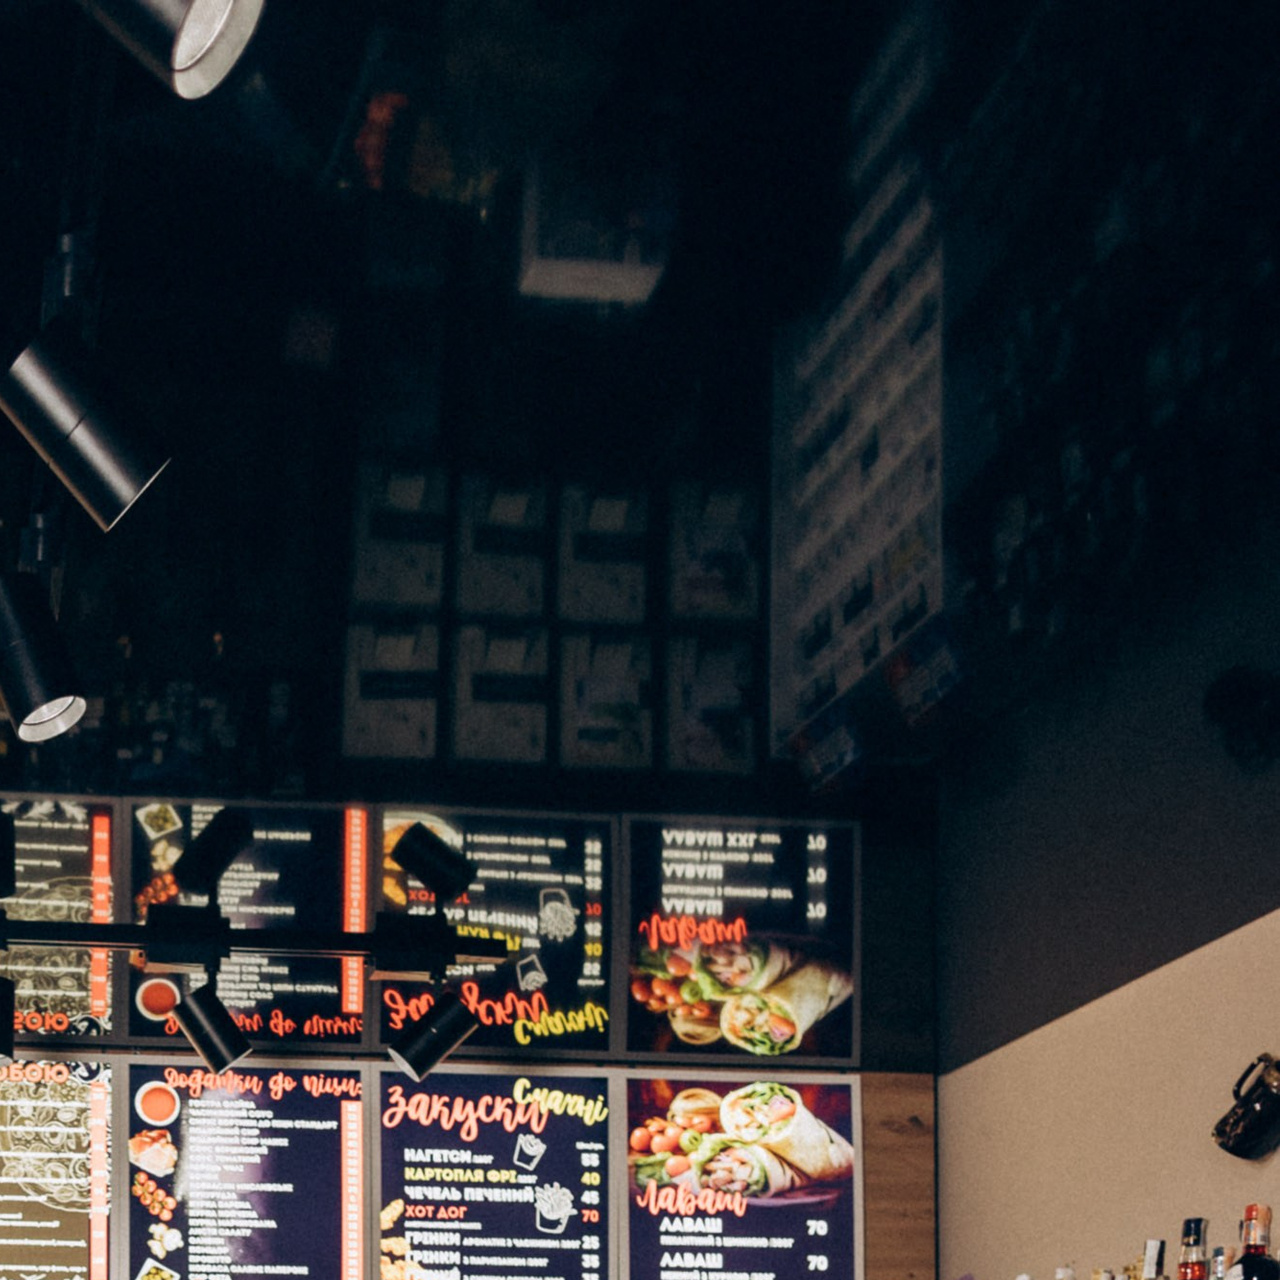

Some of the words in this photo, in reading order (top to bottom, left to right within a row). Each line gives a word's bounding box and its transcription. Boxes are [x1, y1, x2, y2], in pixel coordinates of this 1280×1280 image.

[382, 1084, 550, 1143] Закуски
[513, 1078, 609, 1126] Смачні
[581, 1172, 601, 1186] 40
[581, 1191, 600, 1205] 45
[636, 1178, 748, 1217] Лаваш
[404, 1205, 433, 1218] ХОТ
[437, 1206, 467, 1219] ДОГ
[581, 1210, 600, 1223] 70
[660, 1217, 723, 1233] ЛАВАШ
[806, 1220, 828, 1235] 70
[660, 1253, 723, 1269] ЛАВАШ
[807, 1255, 828, 1270] 70
